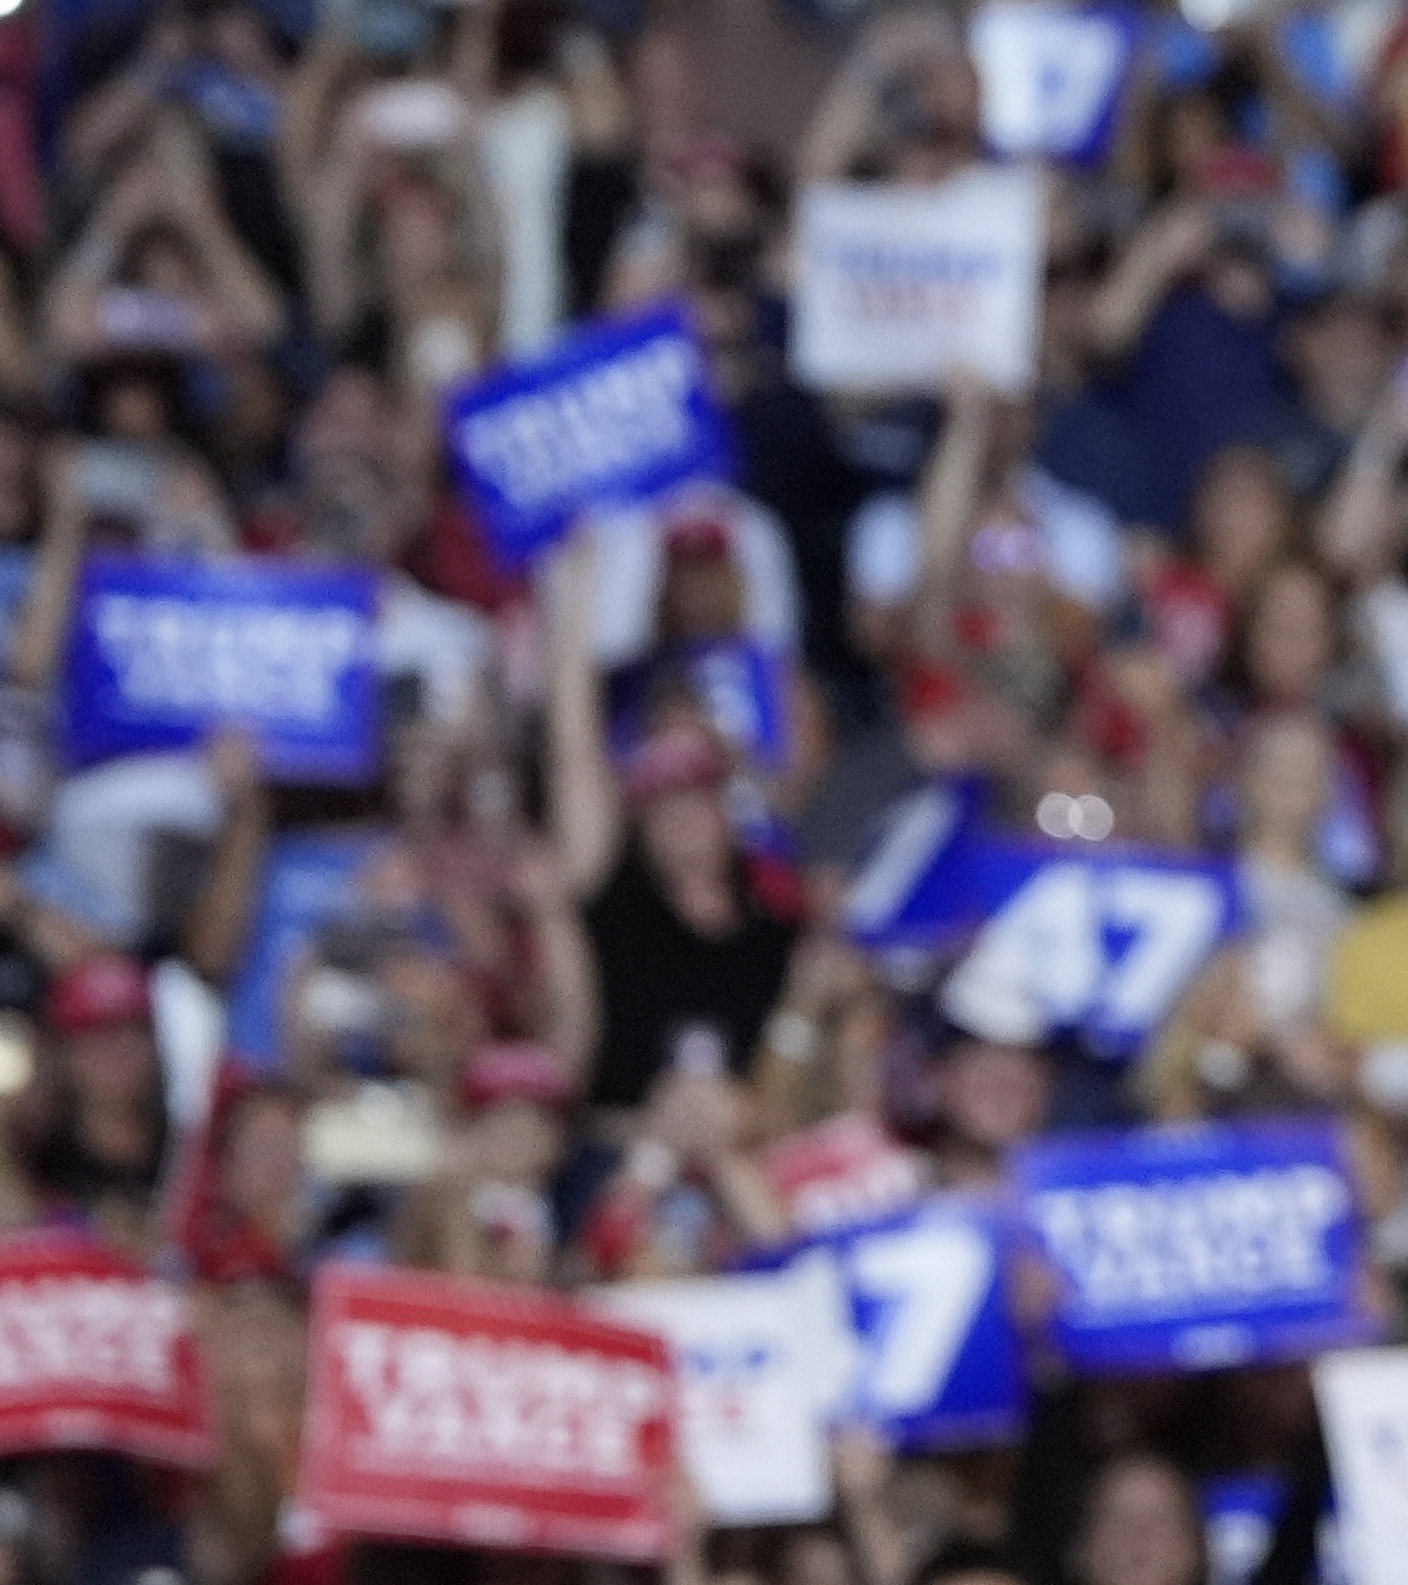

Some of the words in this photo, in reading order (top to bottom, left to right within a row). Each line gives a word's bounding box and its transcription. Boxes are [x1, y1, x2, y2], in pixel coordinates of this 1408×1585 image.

[98, 602, 358, 664] TRUMP
[943, 863, 1225, 1038] 47
[1040, 1168, 1340, 1254] TRUMP
[338, 1322, 664, 1422] TRUMP
[372, 1392, 636, 1468] VANCE
